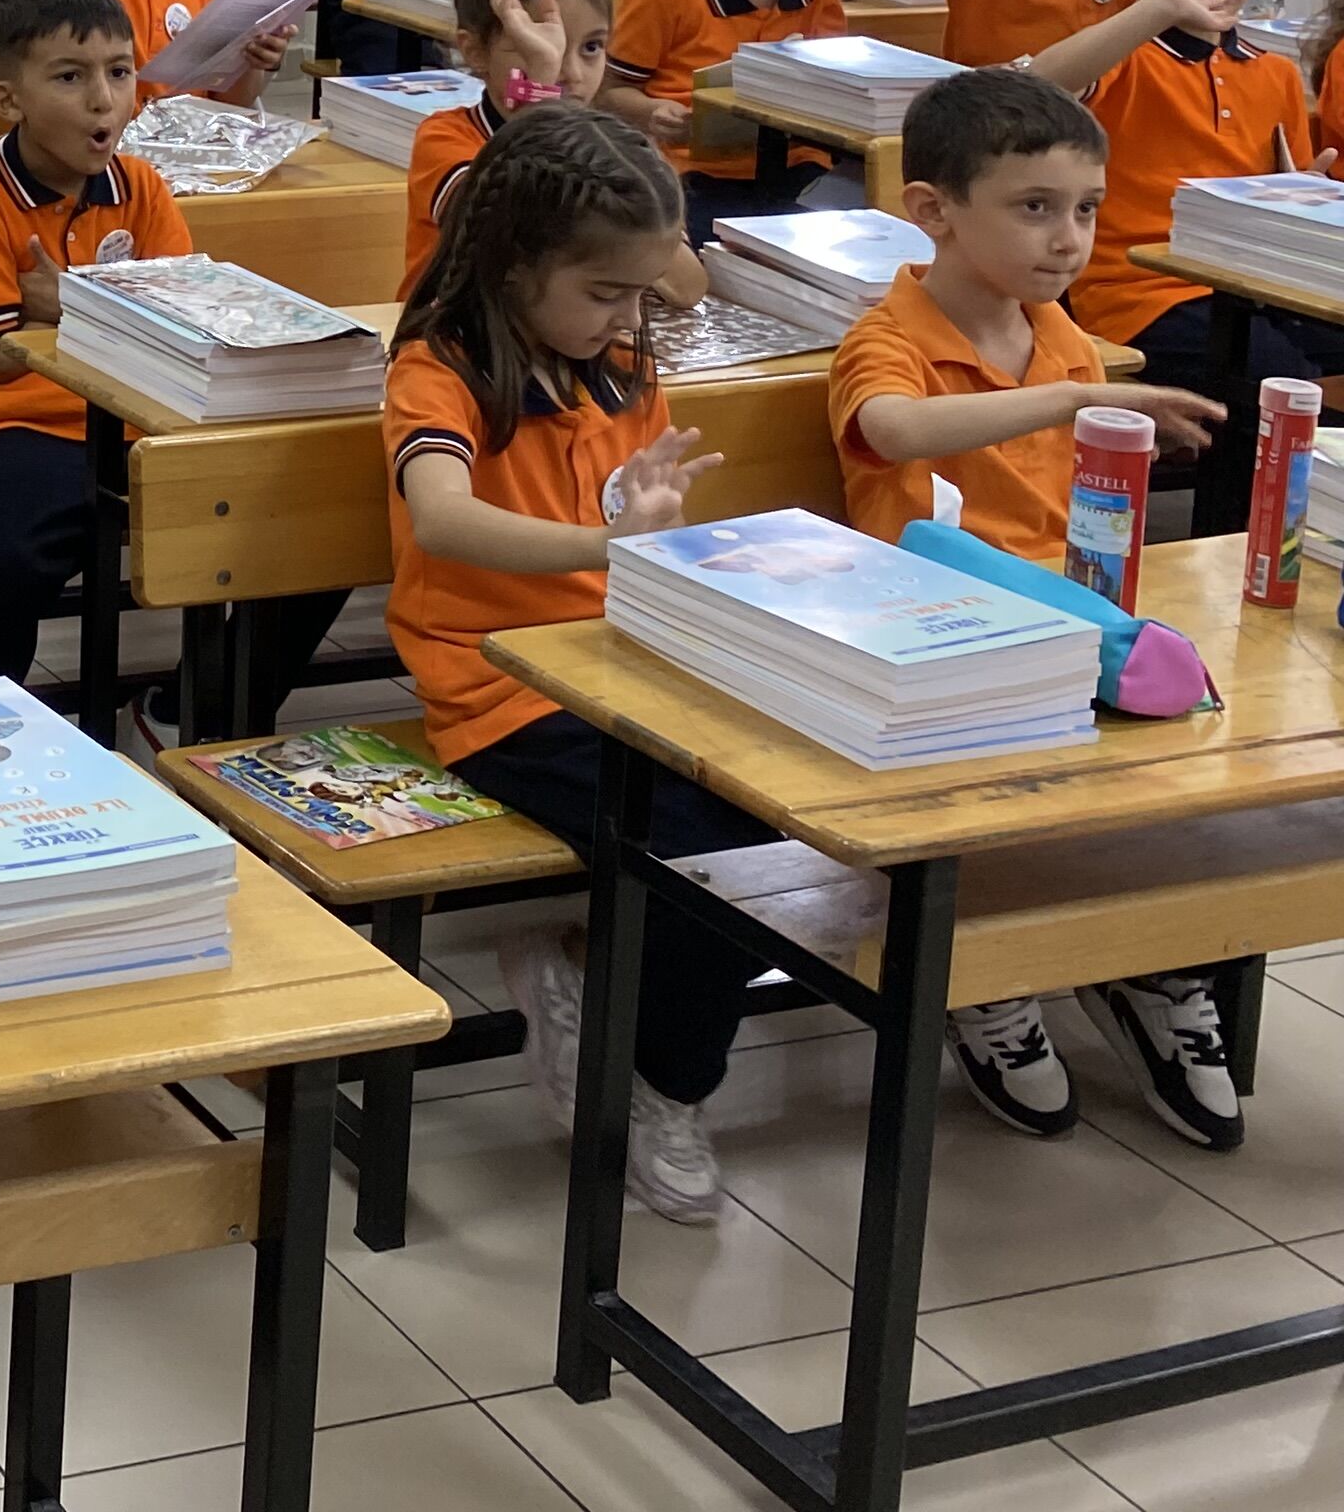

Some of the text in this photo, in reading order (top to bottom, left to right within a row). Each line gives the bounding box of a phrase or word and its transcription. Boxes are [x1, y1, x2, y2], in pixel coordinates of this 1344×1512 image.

[92, 798, 134, 812] İLK
[13, 806, 88, 825] OKUMA
[13, 827, 111, 851] TÜRKÇE
